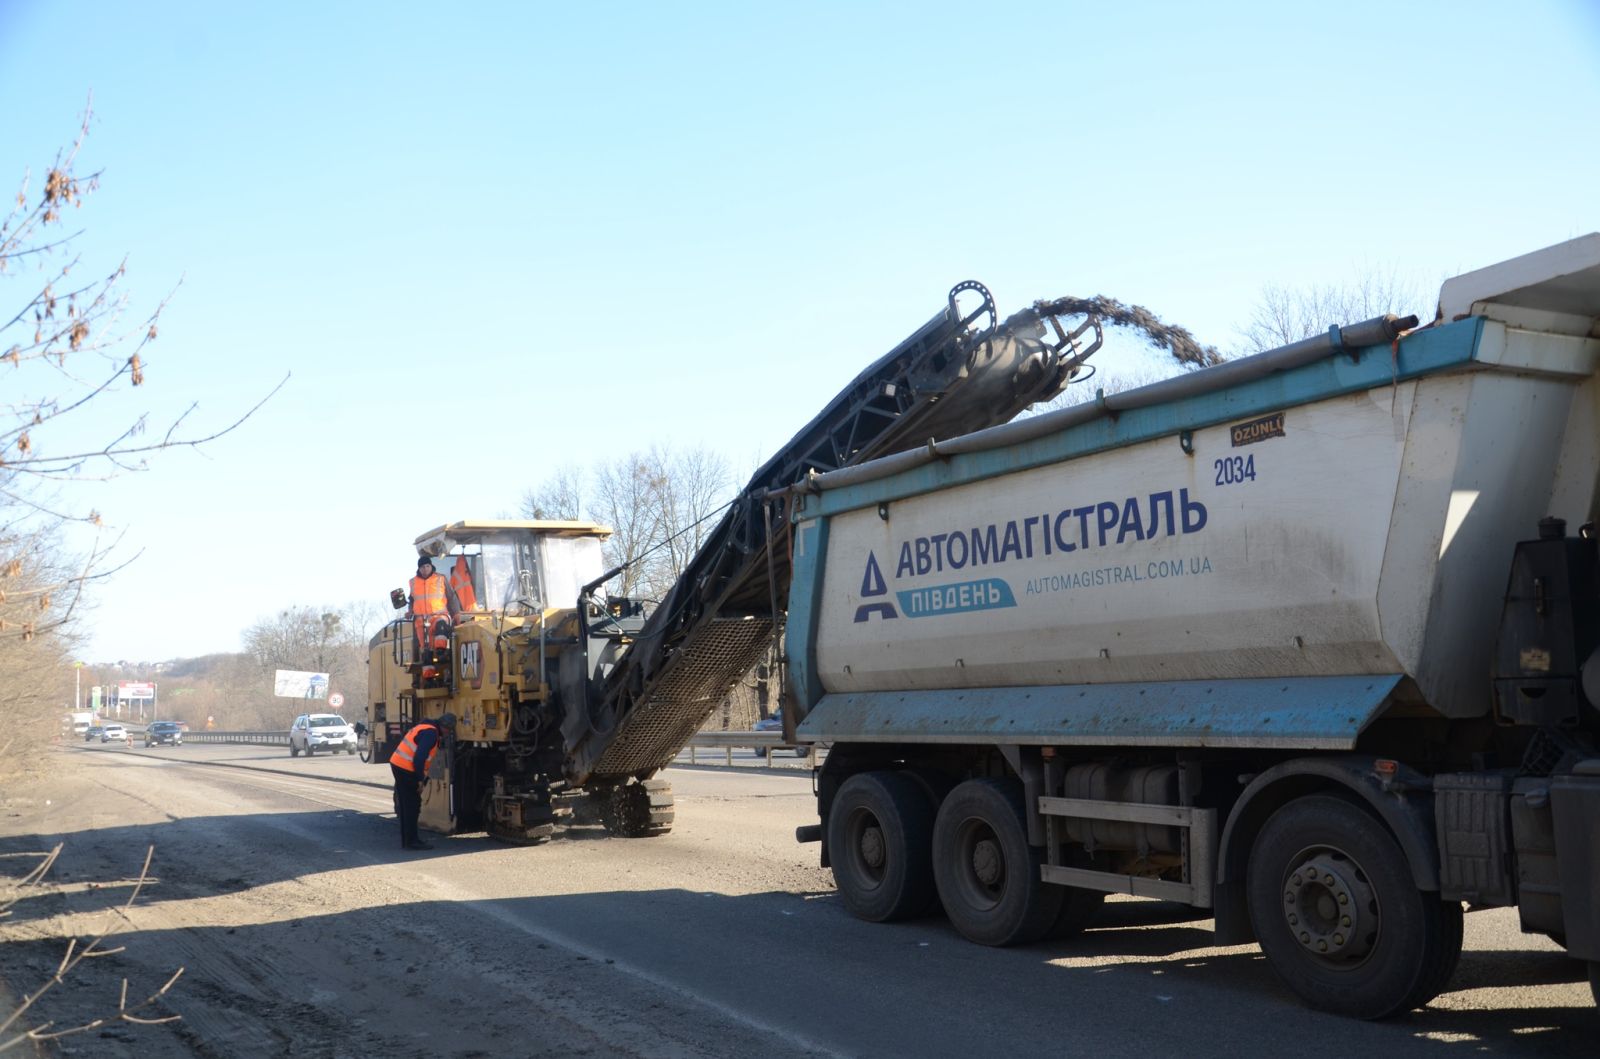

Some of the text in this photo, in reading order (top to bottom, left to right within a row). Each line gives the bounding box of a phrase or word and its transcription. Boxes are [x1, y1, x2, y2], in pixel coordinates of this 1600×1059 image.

[1214, 453, 1256, 486] 2034
[896, 488, 1208, 578] АВТОМАГІСТРАЛЬ
[1026, 557, 1212, 595] AUTOMAGISTRAL.COM.UA
[911, 582, 1001, 612] ПІВДЕНЬ
[461, 642, 479, 679] CAT
